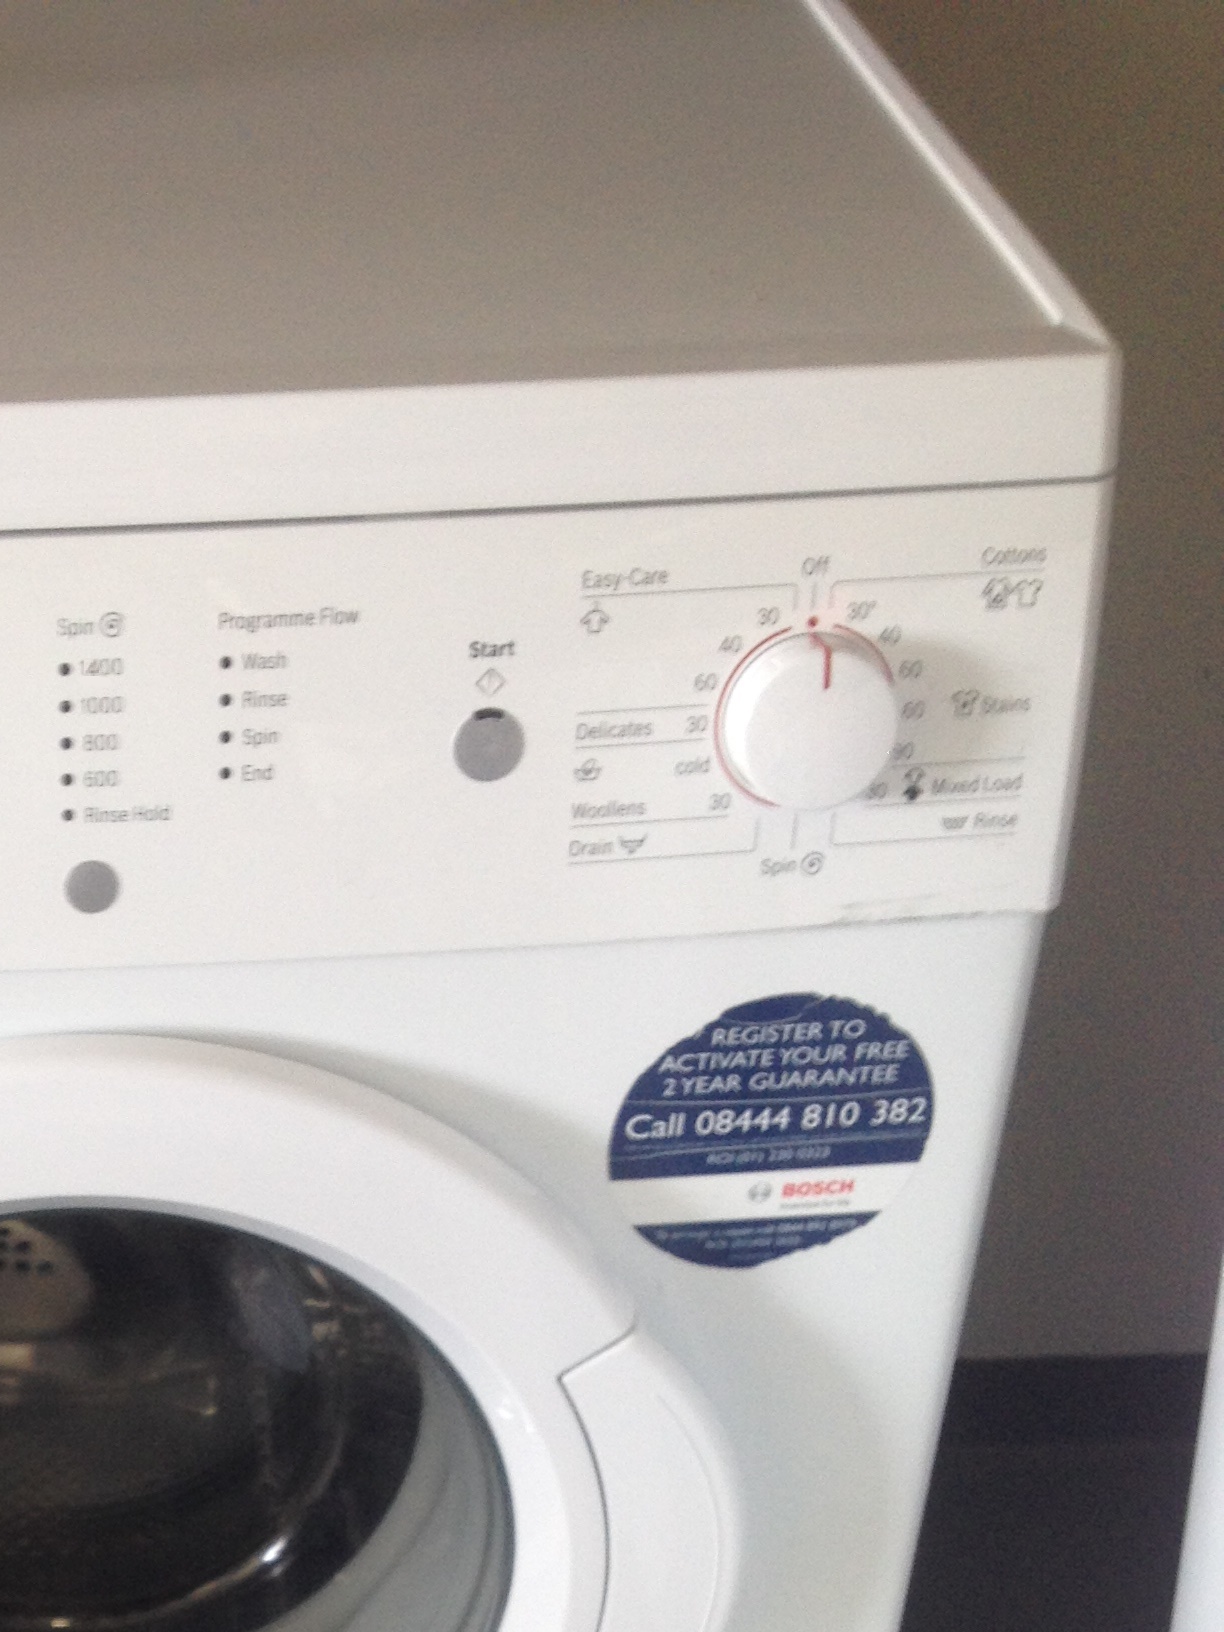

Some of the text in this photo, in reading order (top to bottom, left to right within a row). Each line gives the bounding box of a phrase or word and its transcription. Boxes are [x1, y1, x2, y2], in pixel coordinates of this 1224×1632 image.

[981, 547, 1048, 565] Cottons
[802, 556, 830, 576] Off
[581, 567, 669, 590] Easy-Care
[218, 607, 360, 633] Programme Flow
[756, 606, 782, 626] 30
[57, 618, 94, 638] Spin
[468, 640, 515, 659] Start
[718, 635, 744, 652] 40
[241, 653, 288, 670] Wash
[898, 659, 923, 679] 60
[694, 673, 718, 692] 60
[81, 696, 124, 713] 1000
[241, 691, 288, 708] Rinse
[242, 728, 279, 748] Spin
[576, 722, 653, 741] Delicates
[241, 764, 273, 781] End
[675, 757, 710, 776] cold
[84, 804, 173, 823] Rinse Hold
[571, 800, 646, 819] Woollens
[974, 812, 1018, 827] Rinse
[569, 838, 615, 857] Drain
[760, 857, 798, 877] Spin
[712, 1019, 867, 1046] REGISTER TO
[659, 1039, 911, 1074] ACTIVATE YOUR FREE
[663, 1064, 900, 1097] 2 YEAR GUARANTEE
[626, 1097, 926, 1140] Call 08444 810 382
[782, 1179, 856, 1199] BOSCH
